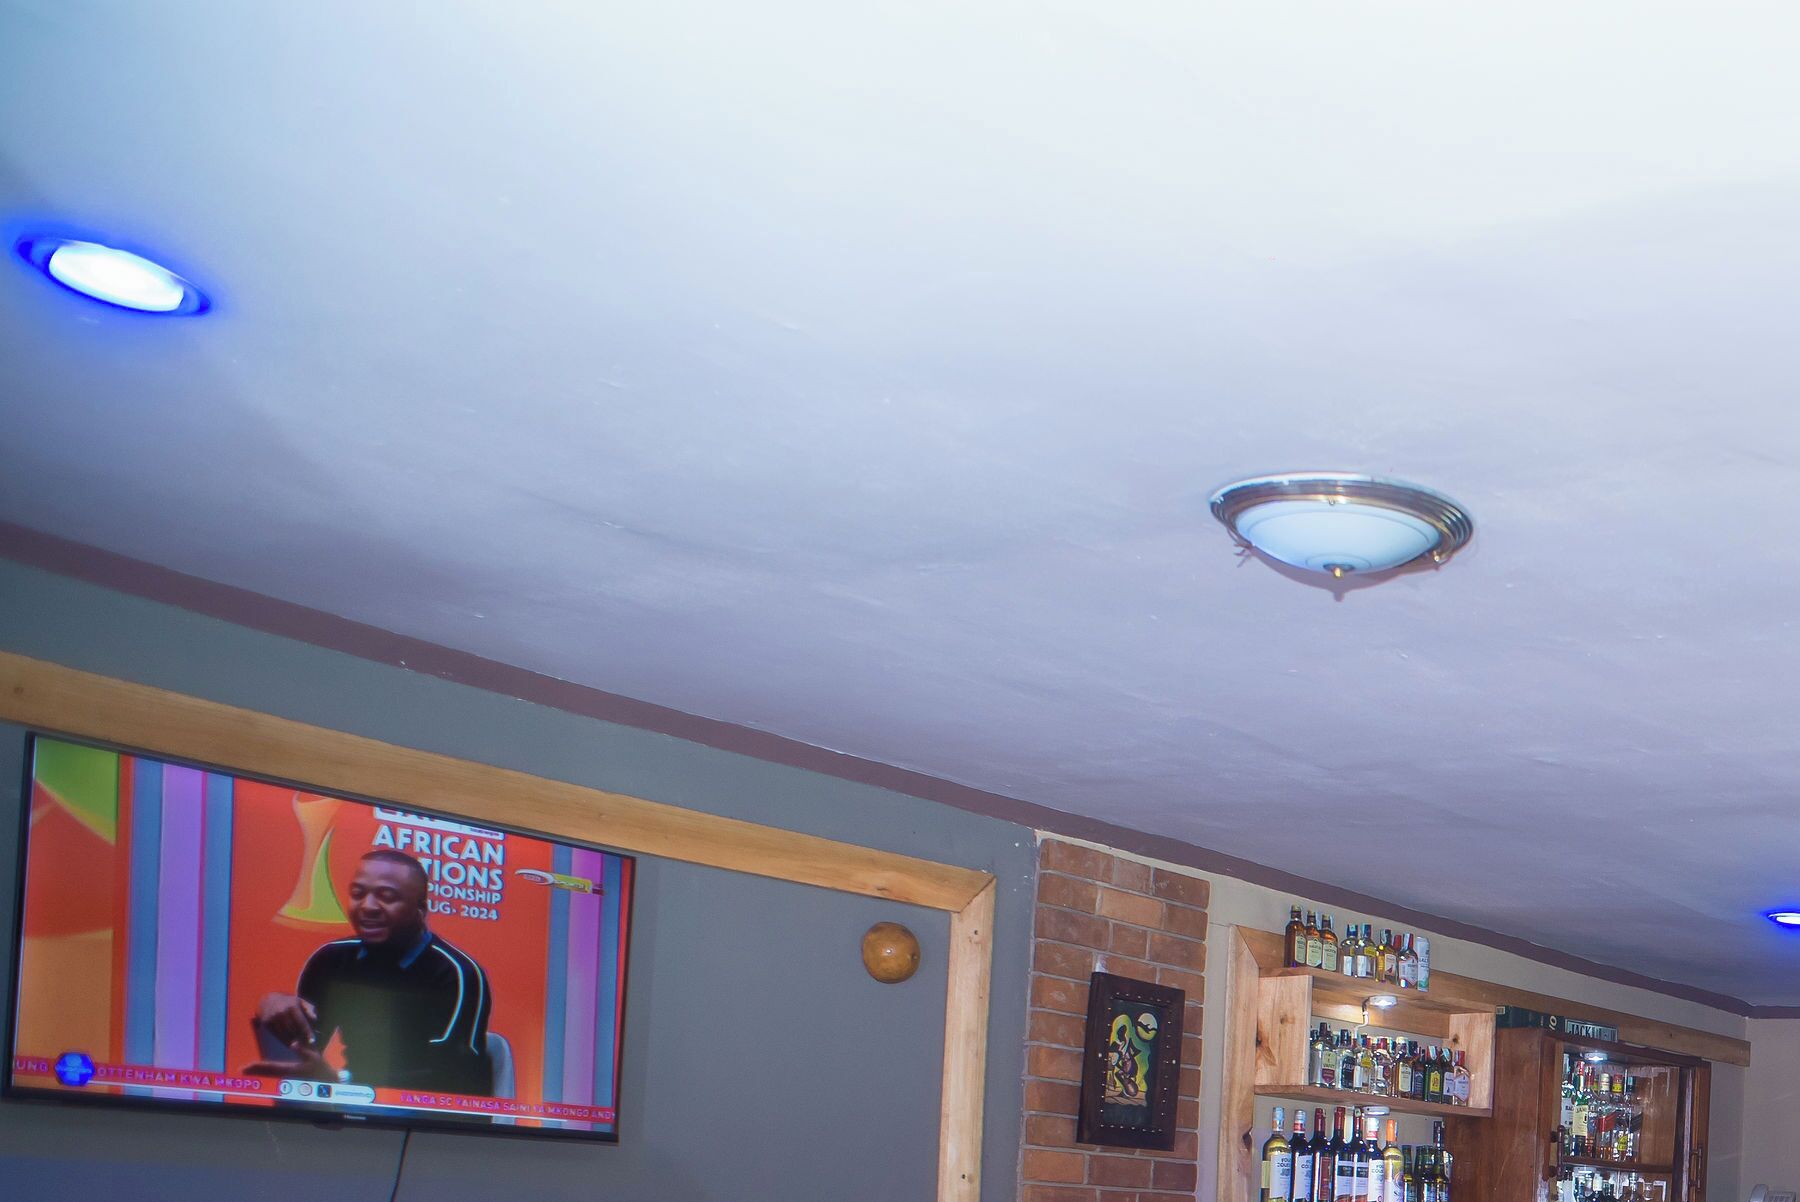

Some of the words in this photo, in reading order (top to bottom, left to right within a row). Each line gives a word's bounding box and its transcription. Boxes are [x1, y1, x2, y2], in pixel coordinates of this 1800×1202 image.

[372, 824, 504, 866] AFRICAN
[421, 858, 504, 891] TIONS
[426, 881, 503, 905] PIONSHIP
[428, 898, 457, 915] UG.
[460, 904, 499, 921] 2024
[99, 1065, 176, 1083] OTTENHAM
